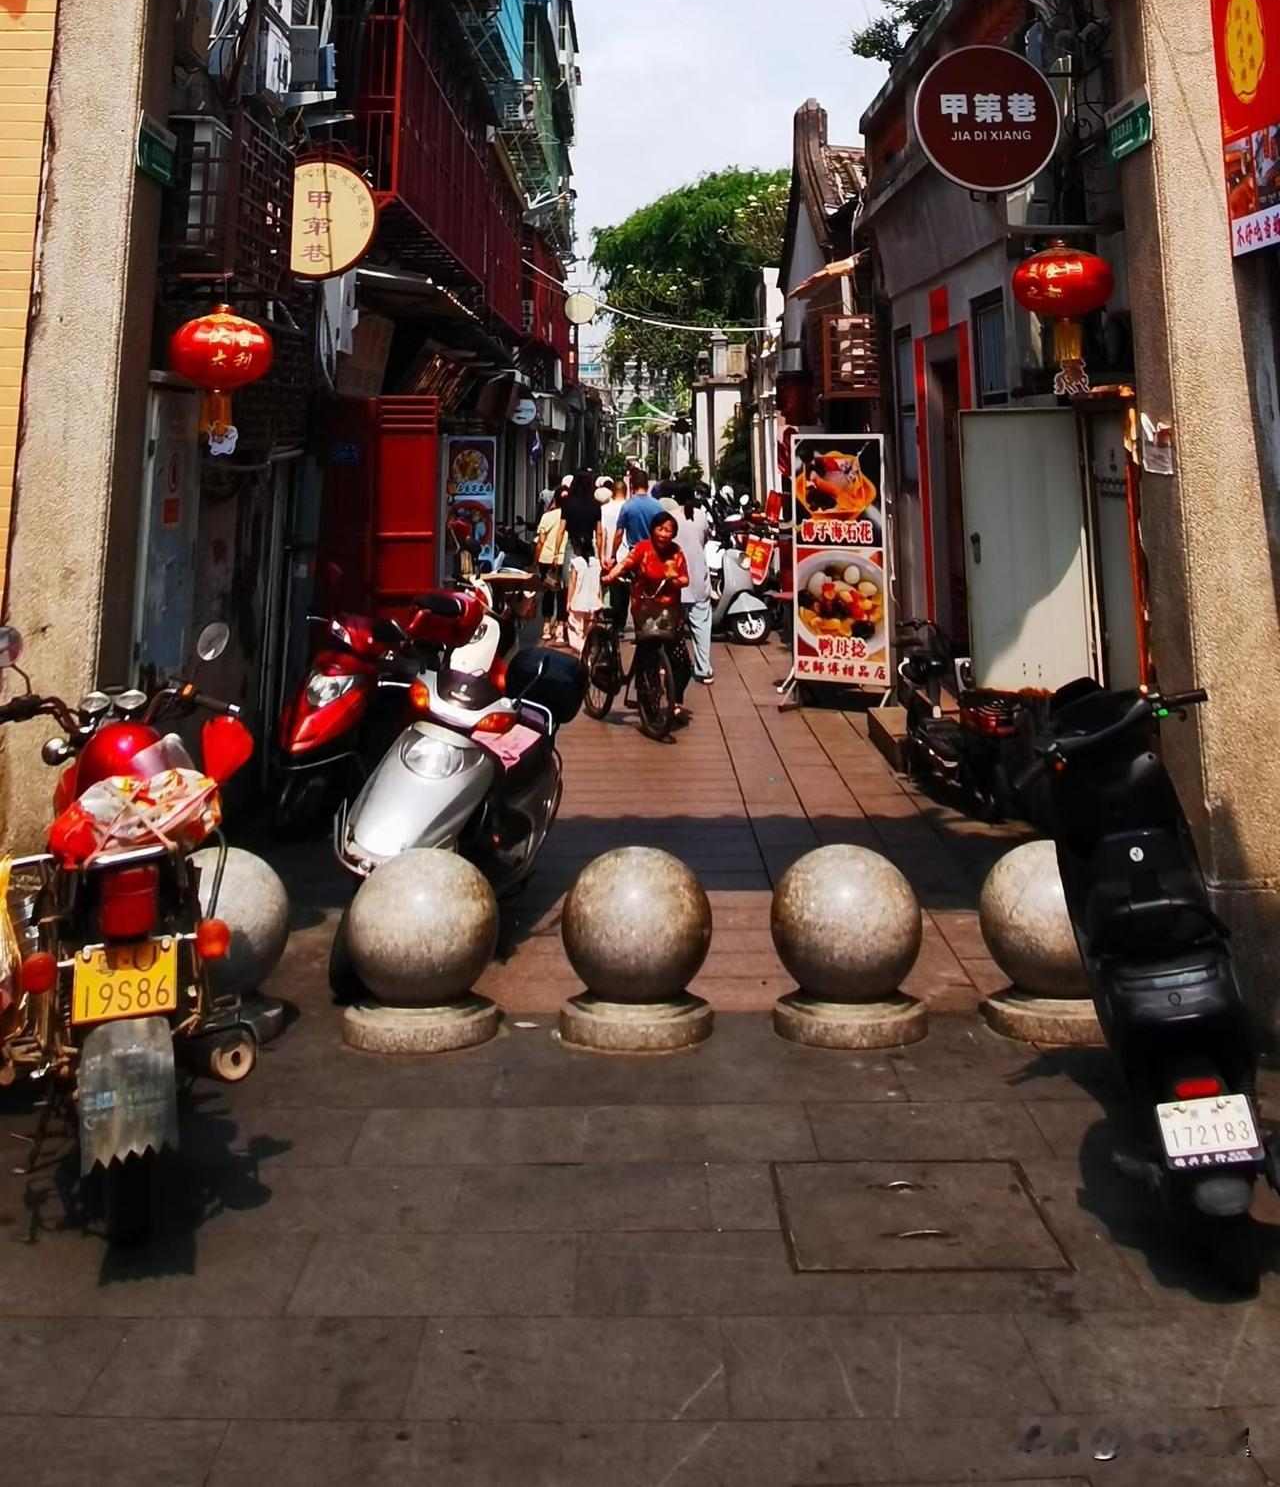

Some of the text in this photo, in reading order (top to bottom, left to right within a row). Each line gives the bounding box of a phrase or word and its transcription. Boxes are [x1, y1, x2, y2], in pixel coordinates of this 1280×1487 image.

[940, 93, 1037, 123] 甲第巷
[951, 131, 1032, 141] JIA DI XIANG
[300, 190, 333, 263] 甲第巷
[84, 974, 170, 1018] 19S86
[1170, 1120, 1250, 1149] 172183
